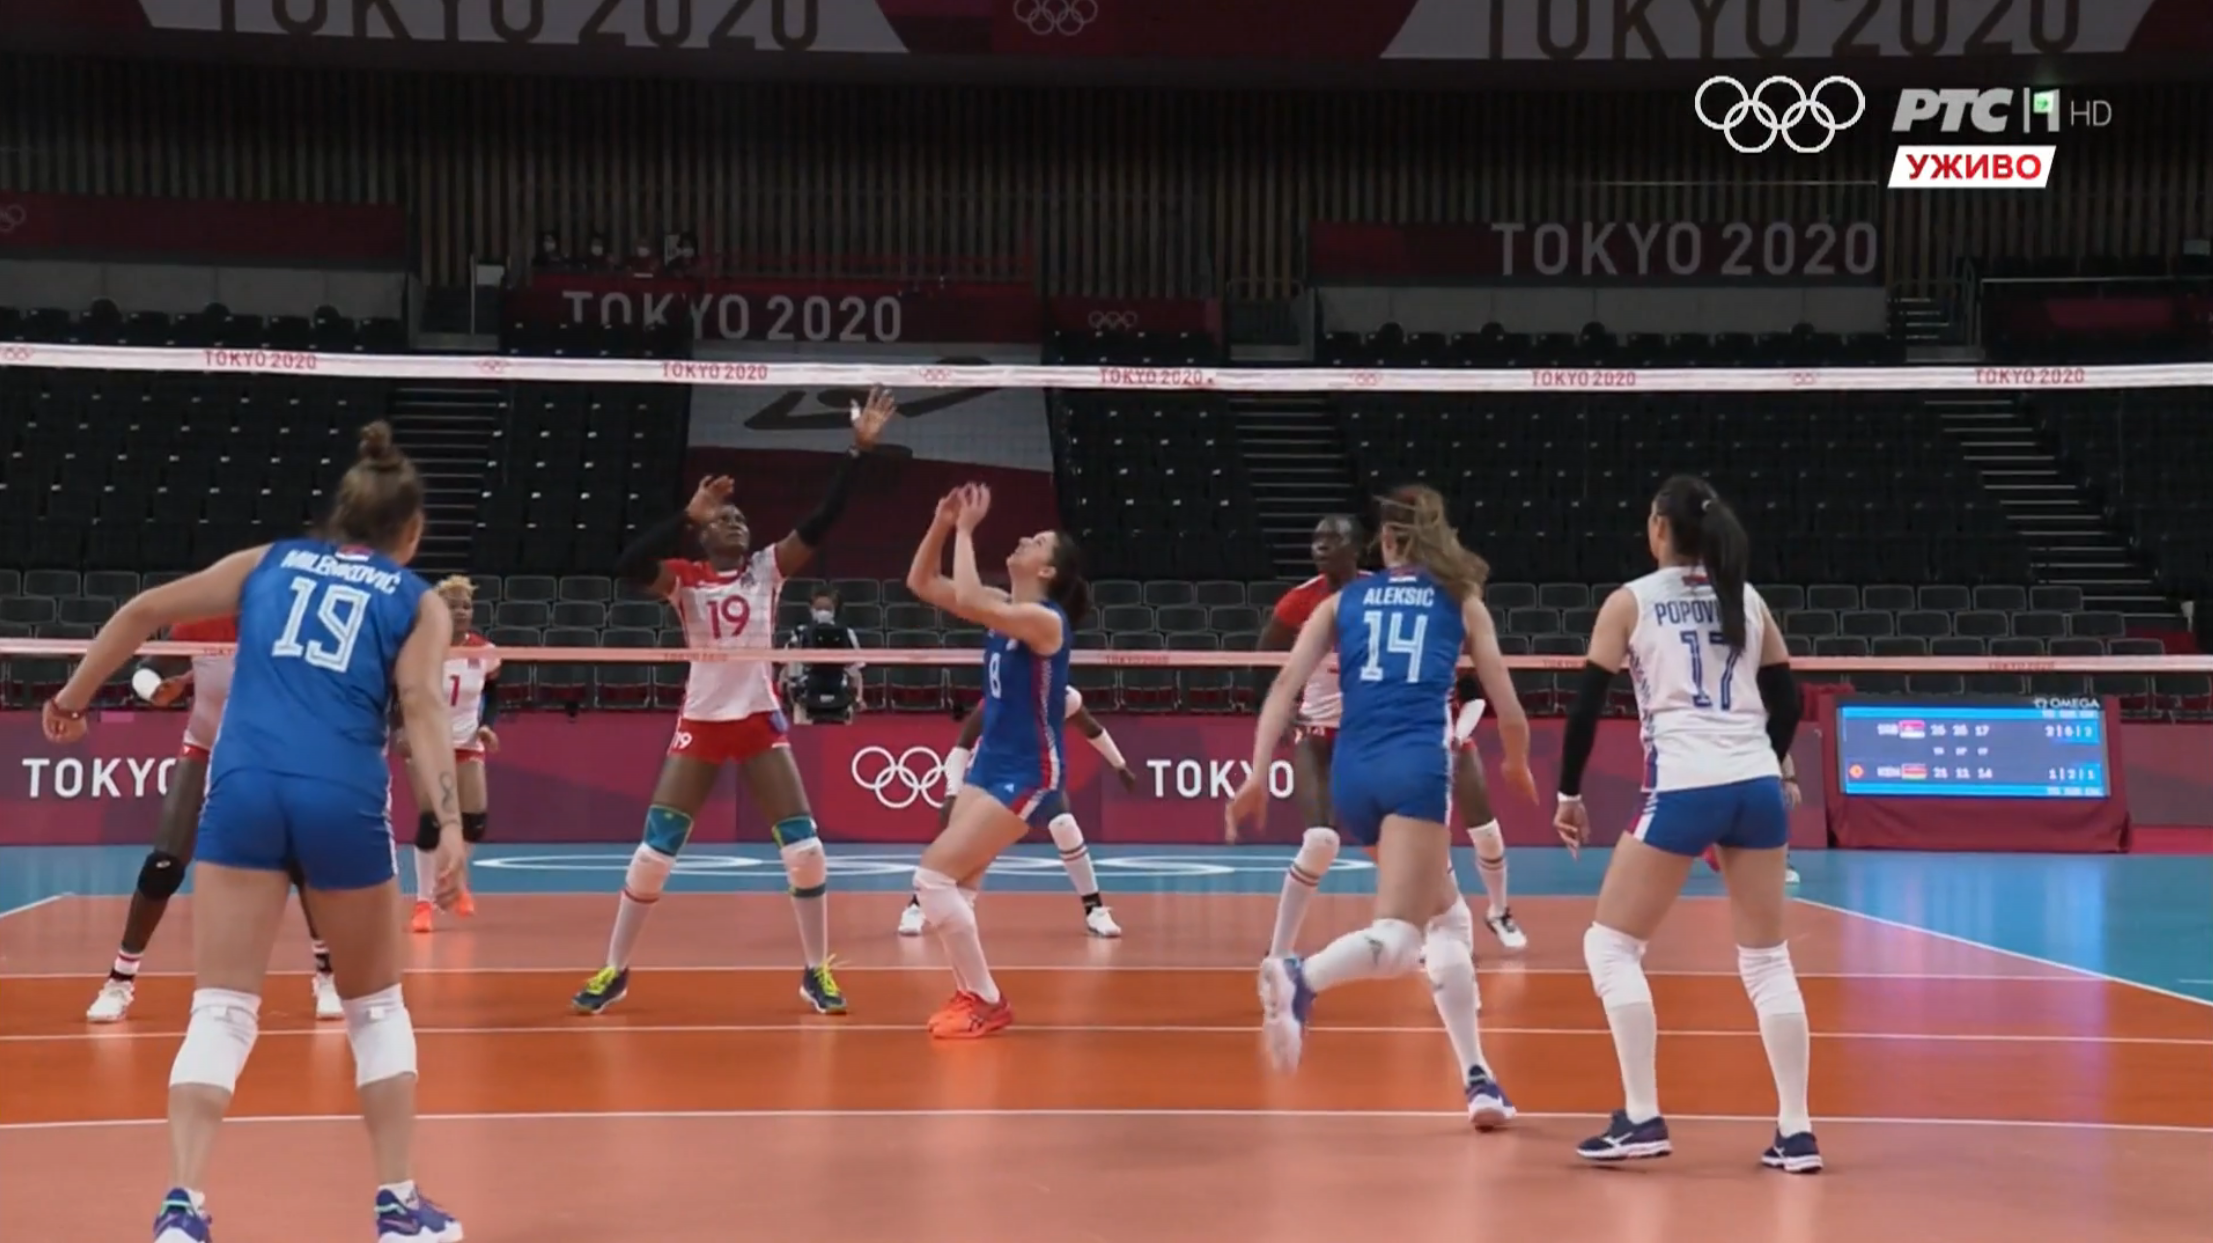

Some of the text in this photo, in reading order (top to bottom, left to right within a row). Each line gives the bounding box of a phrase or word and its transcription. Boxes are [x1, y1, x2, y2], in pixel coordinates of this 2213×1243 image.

[1490, 221, 1878, 276] TOKYO 2020
[562, 291, 901, 342] TOKYO 2020
[204, 349, 317, 370] TOKYO 2020
[662, 361, 768, 380] TOKYO 2020
[1100, 367, 1203, 385] TOKYO 2020
[1532, 370, 1637, 387] TOKYO 2020
[1975, 366, 2085, 385] TOKYO 2020
[271, 576, 371, 672] 19
[707, 594, 750, 640] 19
[1360, 610, 1428, 683] 14
[989, 652, 1002, 699] 8
[1680, 630, 1741, 711] 17
[2049, 697, 2100, 709] OMEGA
